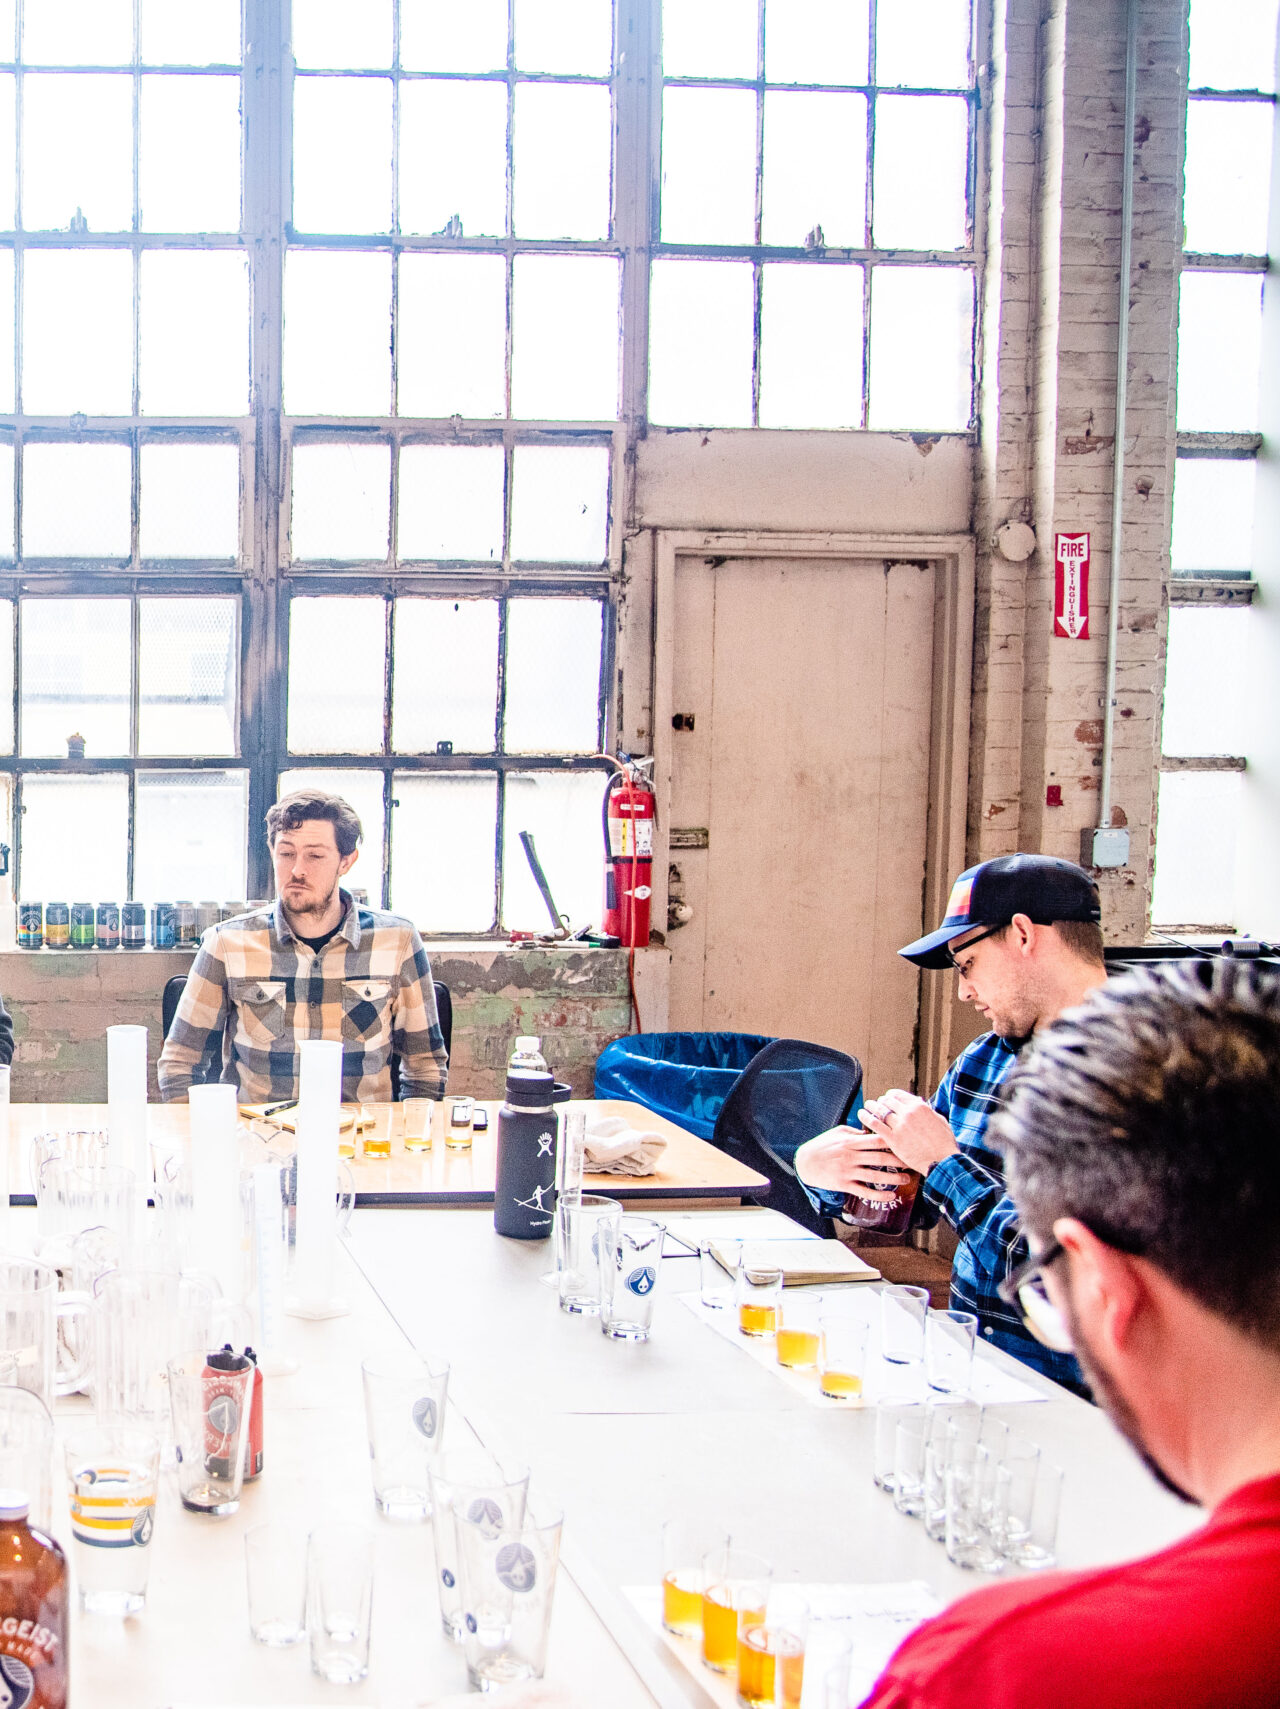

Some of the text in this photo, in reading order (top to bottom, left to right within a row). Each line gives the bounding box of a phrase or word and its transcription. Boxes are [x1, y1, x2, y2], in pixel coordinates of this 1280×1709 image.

[1060, 542, 1084, 557] FIRE
[1068, 560, 1076, 634] EXTINGUISHER
[858, 1196, 903, 1211] EWERY
